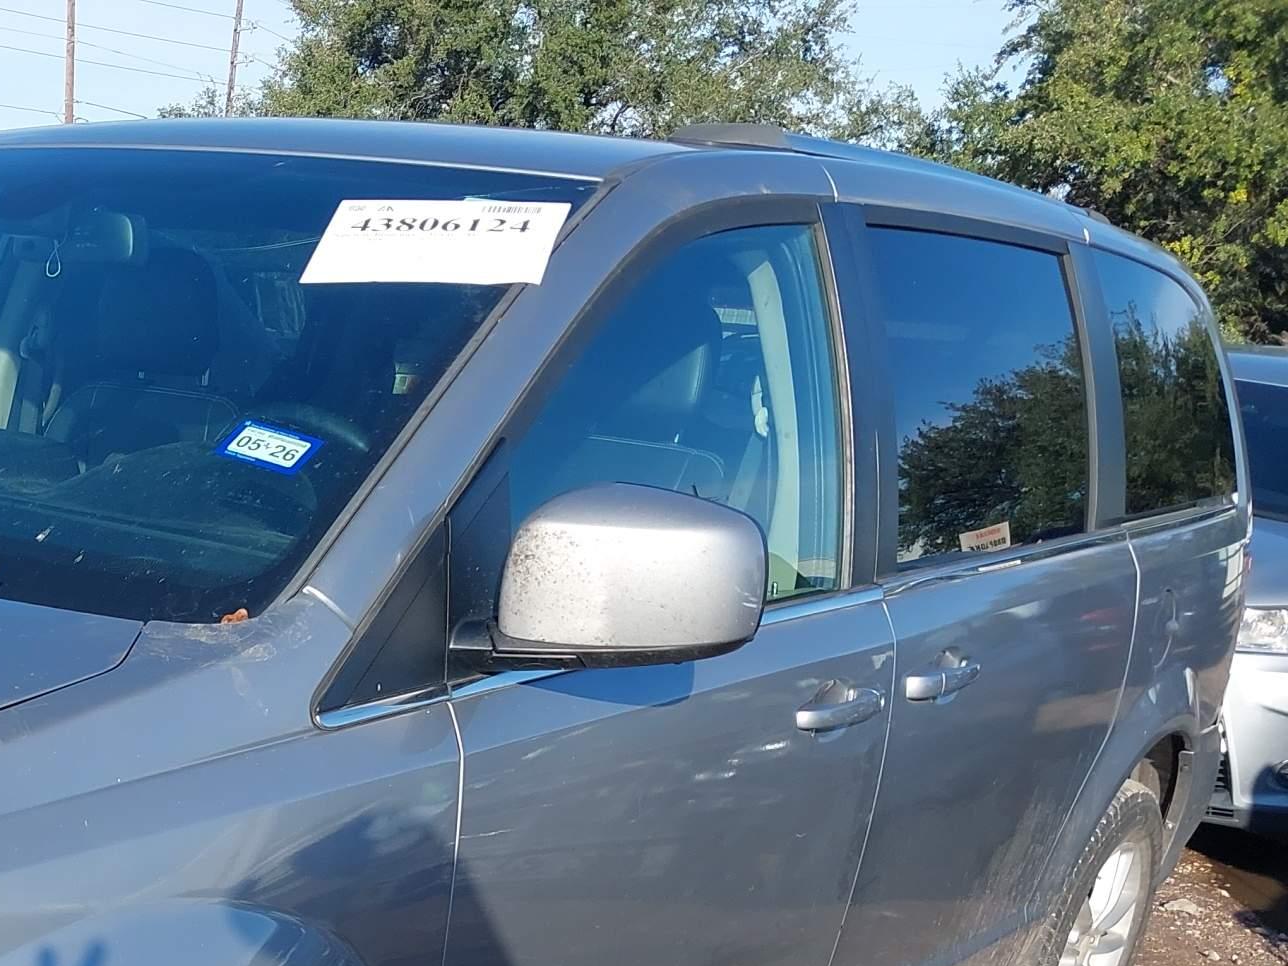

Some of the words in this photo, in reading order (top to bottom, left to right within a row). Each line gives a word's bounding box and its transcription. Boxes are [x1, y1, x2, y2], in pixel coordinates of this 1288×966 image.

[351, 217, 531, 233] 43806124
[236, 436, 265, 451] 05
[269, 445, 300, 462] 26
